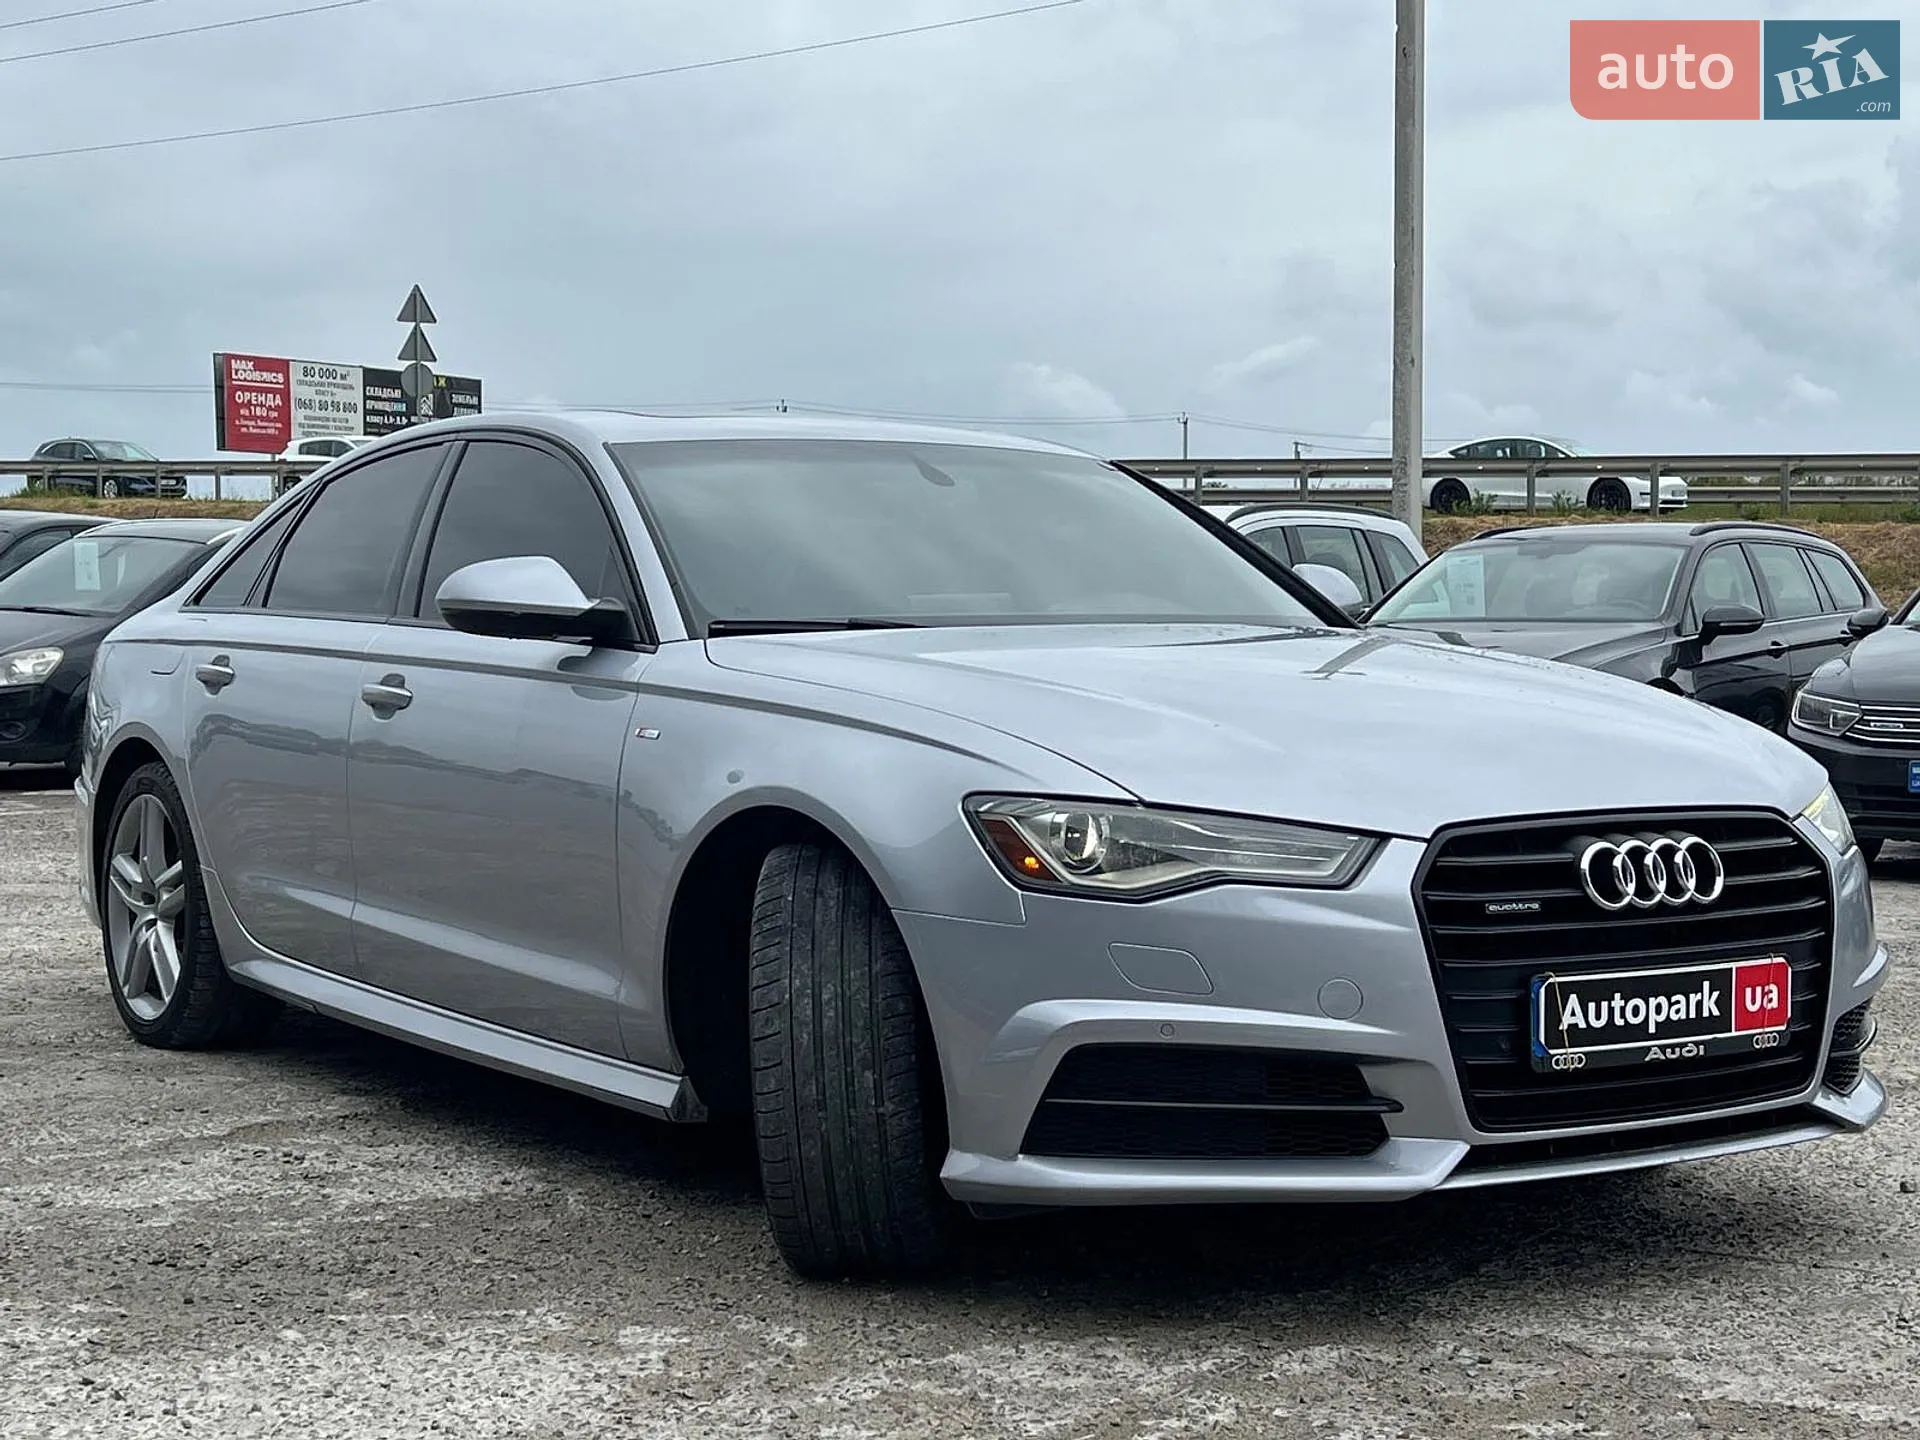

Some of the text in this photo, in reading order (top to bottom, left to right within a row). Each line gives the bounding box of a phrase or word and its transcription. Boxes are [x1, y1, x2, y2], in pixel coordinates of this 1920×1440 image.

[231, 359, 254, 369] MAX
[302, 366, 316, 378] 80
[318, 367, 338, 379] 000
[235, 391, 282, 408] ОРЕНДА
[294, 397, 316, 412] (068)
[318, 400, 328, 411] 80
[1489, 903, 1539, 911] quattro
[1559, 981, 1778, 1033] Autopark ua
[1645, 1044, 1704, 1062] Audi
